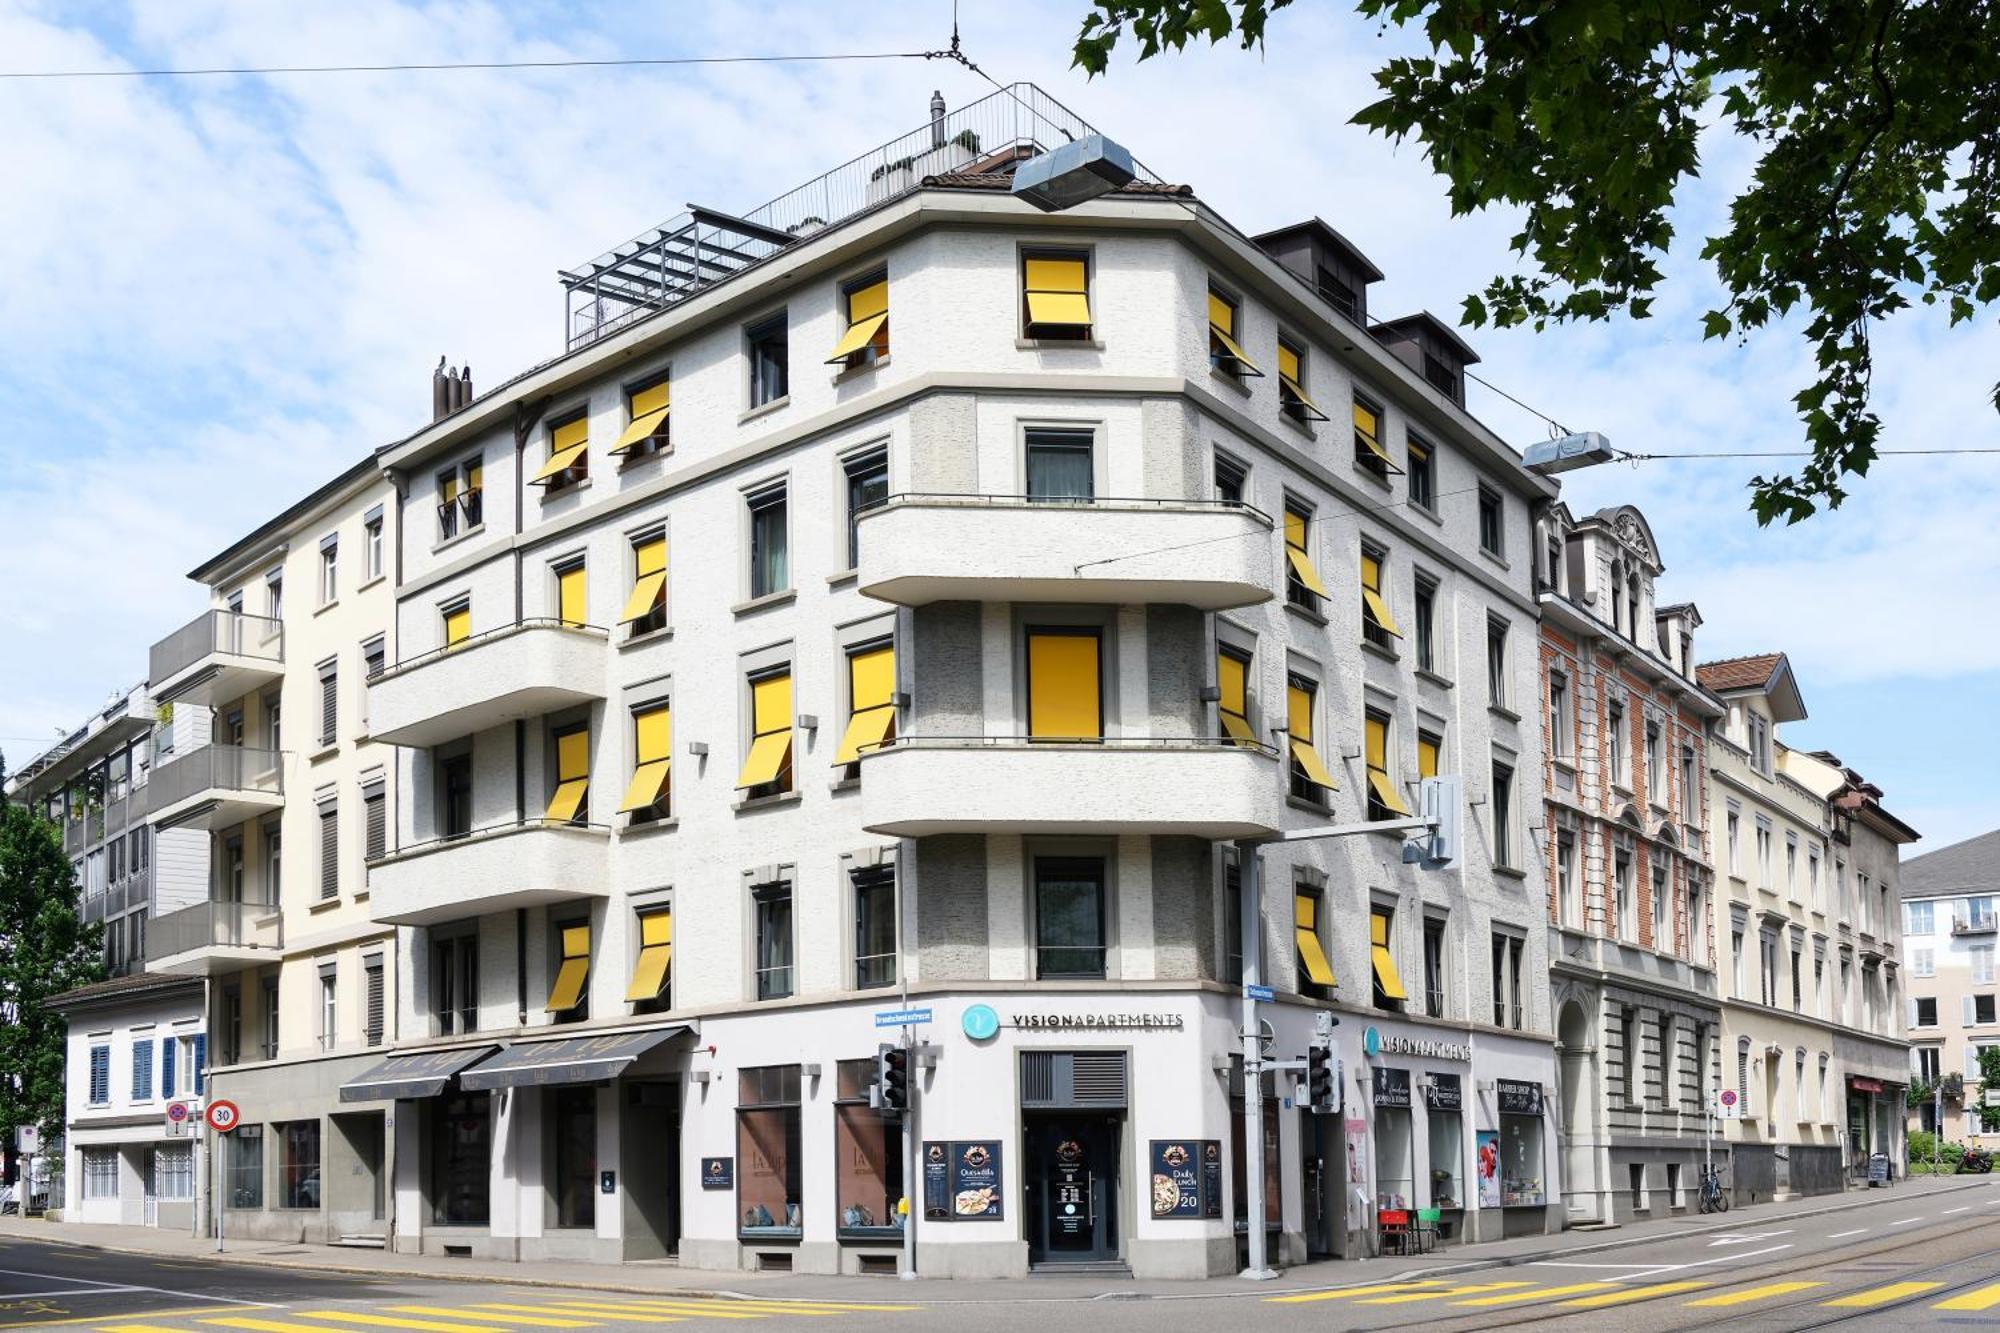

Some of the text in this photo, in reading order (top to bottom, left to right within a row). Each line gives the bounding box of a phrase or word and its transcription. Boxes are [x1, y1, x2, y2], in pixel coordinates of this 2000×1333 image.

[1013, 1014, 1184, 1027] VISIONAPARTMENTS
[216, 1110, 230, 1121] 30
[1181, 1196, 1197, 1207] 20
